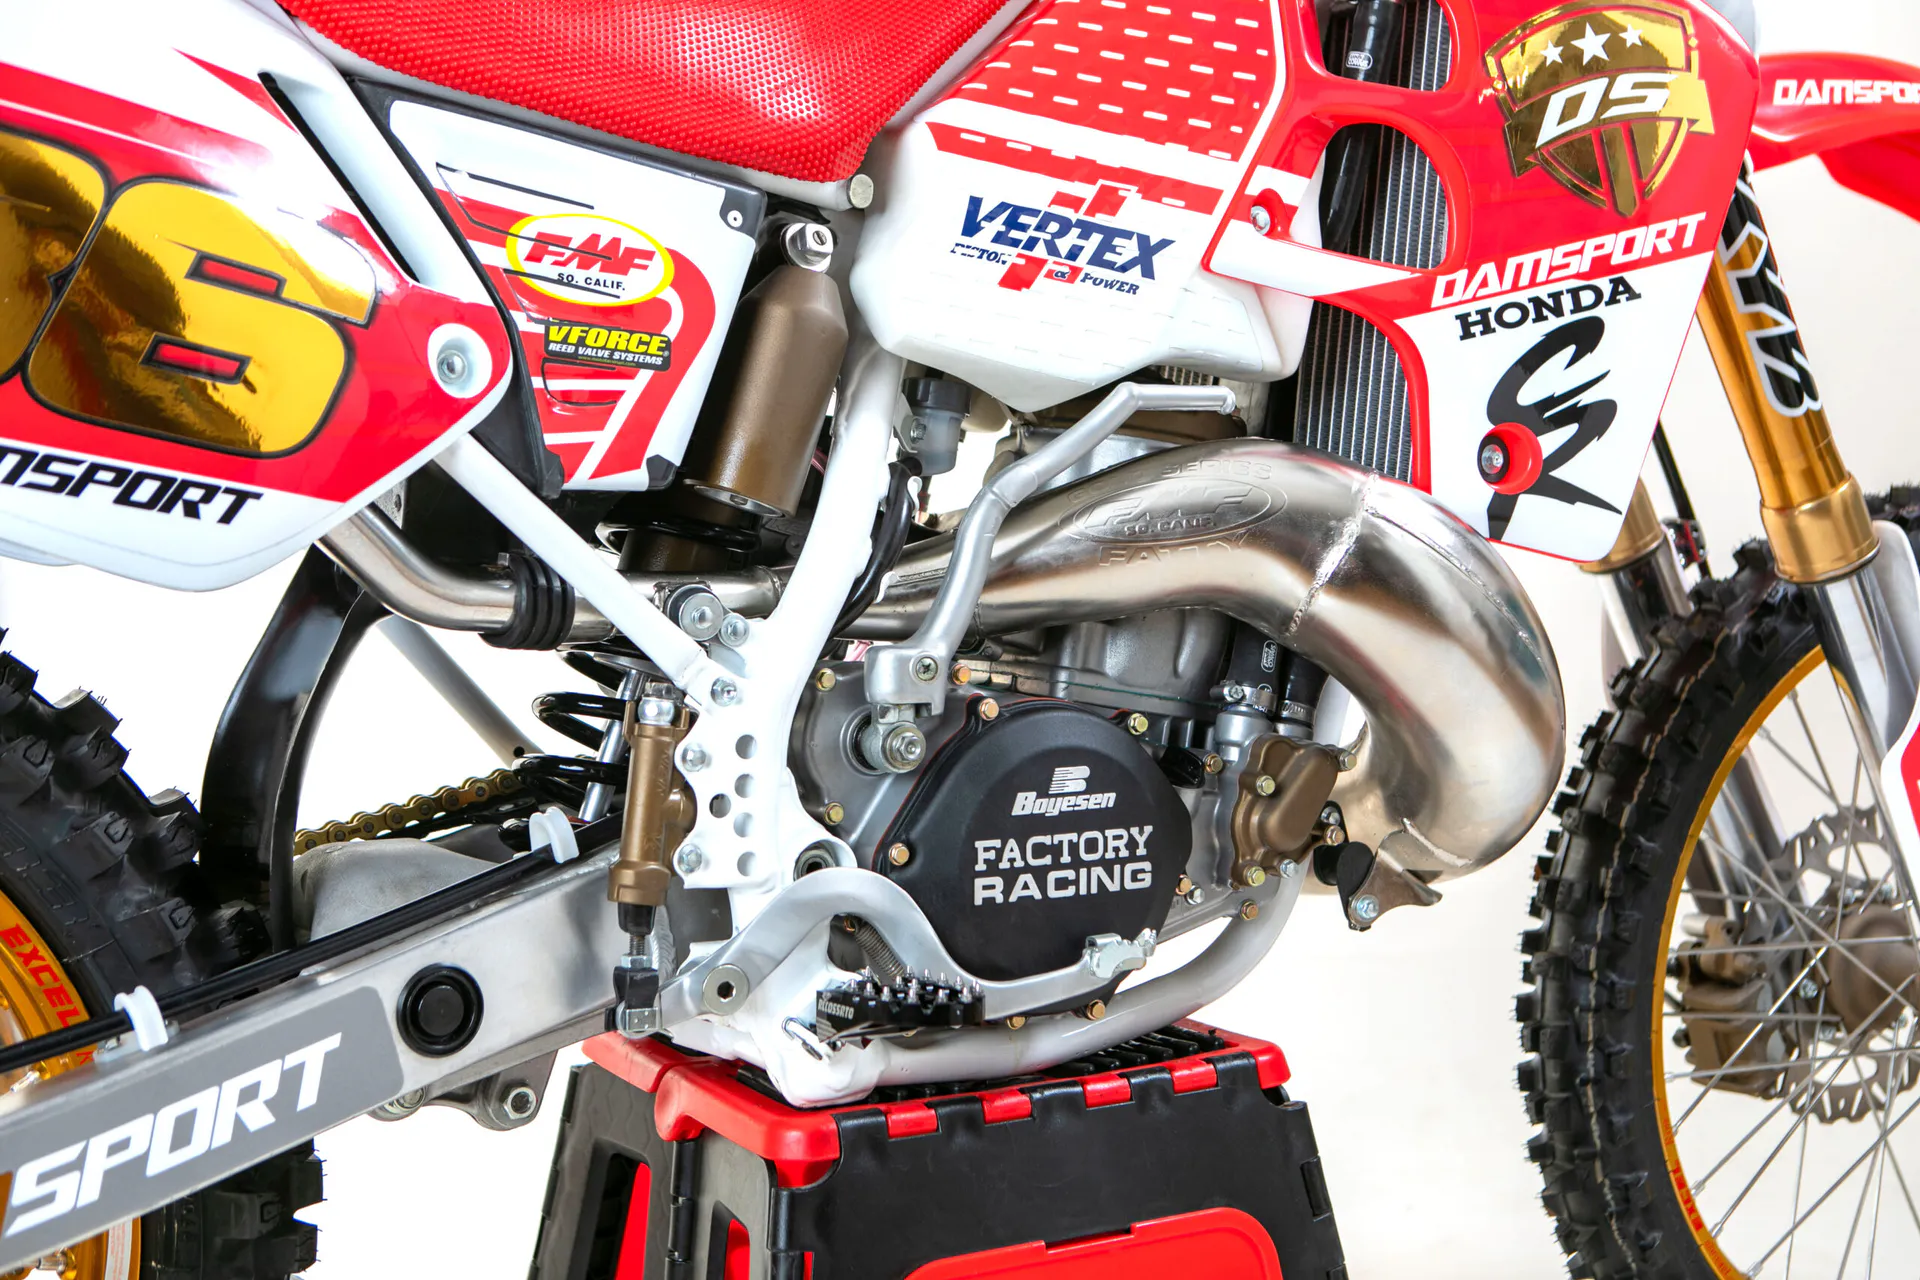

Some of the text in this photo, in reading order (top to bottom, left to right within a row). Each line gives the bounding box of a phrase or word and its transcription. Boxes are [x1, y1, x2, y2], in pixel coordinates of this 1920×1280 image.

[1535, 72, 1678, 149] DS
[524, 231, 656, 276] FMF
[961, 195, 1176, 281] VERTEX
[1431, 211, 1707, 309] DAMSPORT
[557, 272, 626, 291] SO. CALIF.
[1080, 271, 1140, 295] POWER
[1455, 275, 1642, 341] HONDA
[548, 320, 669, 356] VFORCE
[548, 342, 575, 354] REED
[578, 346, 611, 359] VALVE
[612, 351, 663, 365] SYSTEMS
[1011, 791, 1117, 816] Boyesen
[974, 825, 1153, 871] FACTORY
[973, 861, 1152, 906] RACING
[0, 922, 81, 1028] EXCEL
[4, 1031, 342, 1238] SPORT
